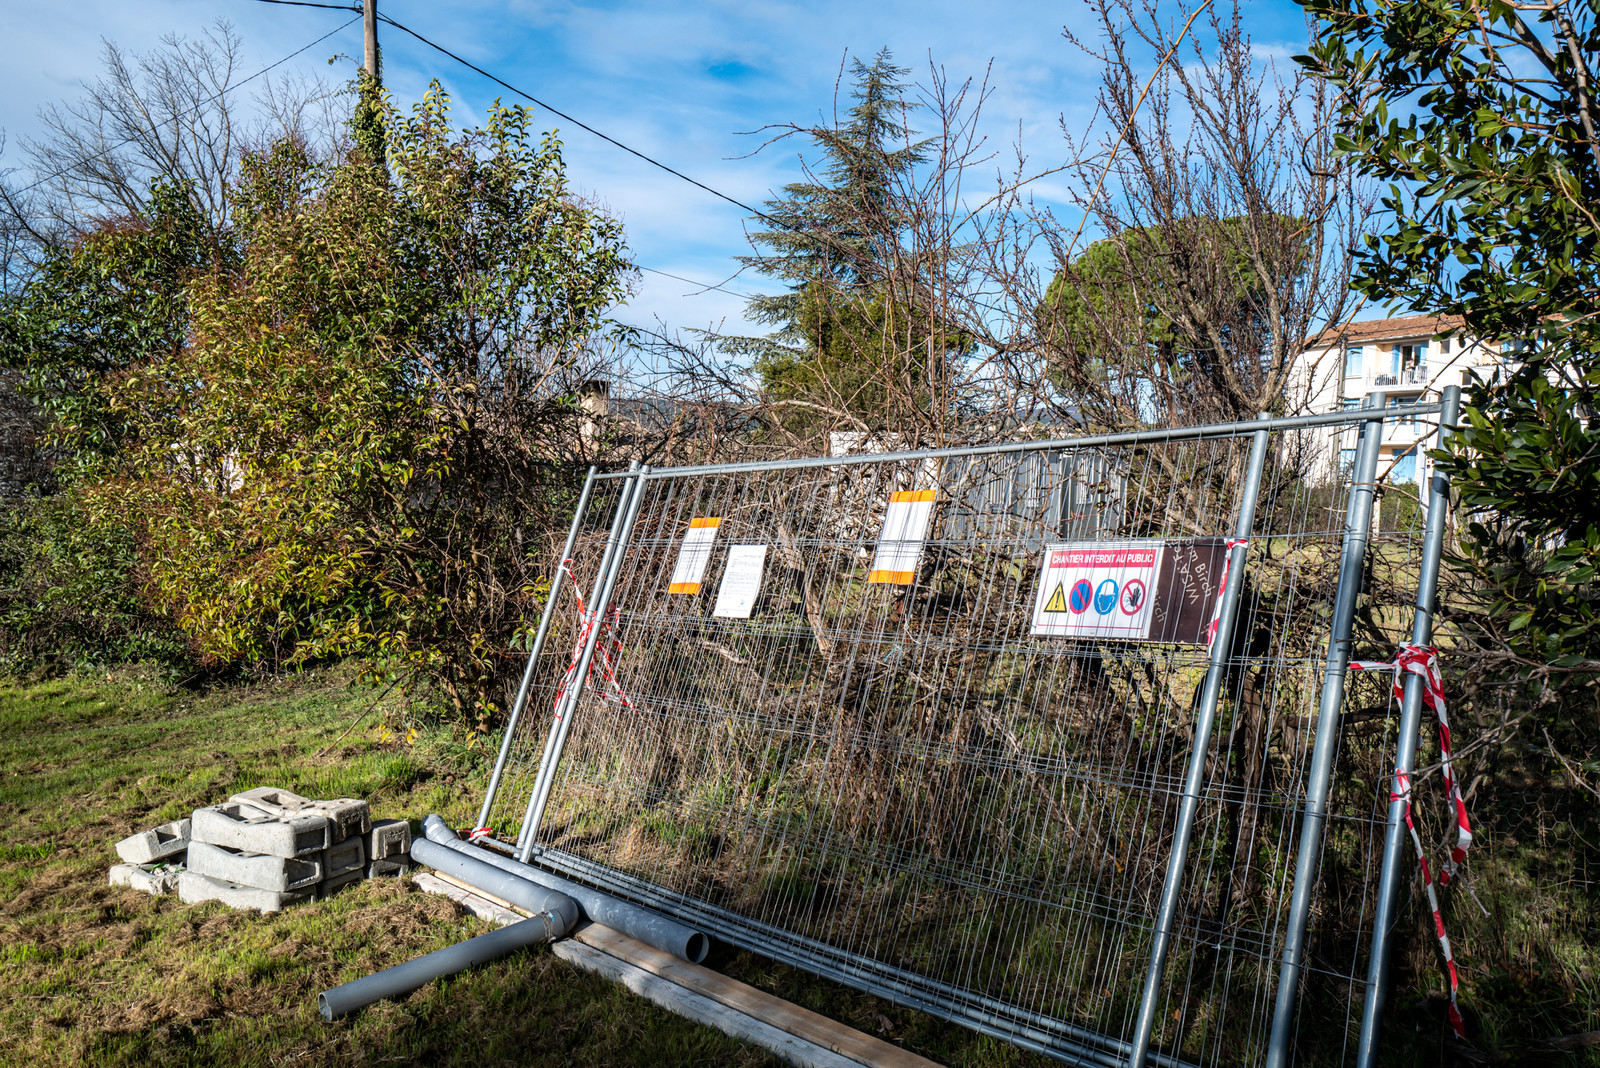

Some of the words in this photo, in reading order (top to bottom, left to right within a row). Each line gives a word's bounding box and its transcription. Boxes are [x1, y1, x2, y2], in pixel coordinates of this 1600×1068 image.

[1052, 555, 1084, 564] CHANTIER
[1084, 554, 1115, 563] INTERDIT
[1115, 554, 1127, 563] AU
[1127, 553, 1154, 563] PUBLIC
[1194, 563, 1216, 598] Birch
